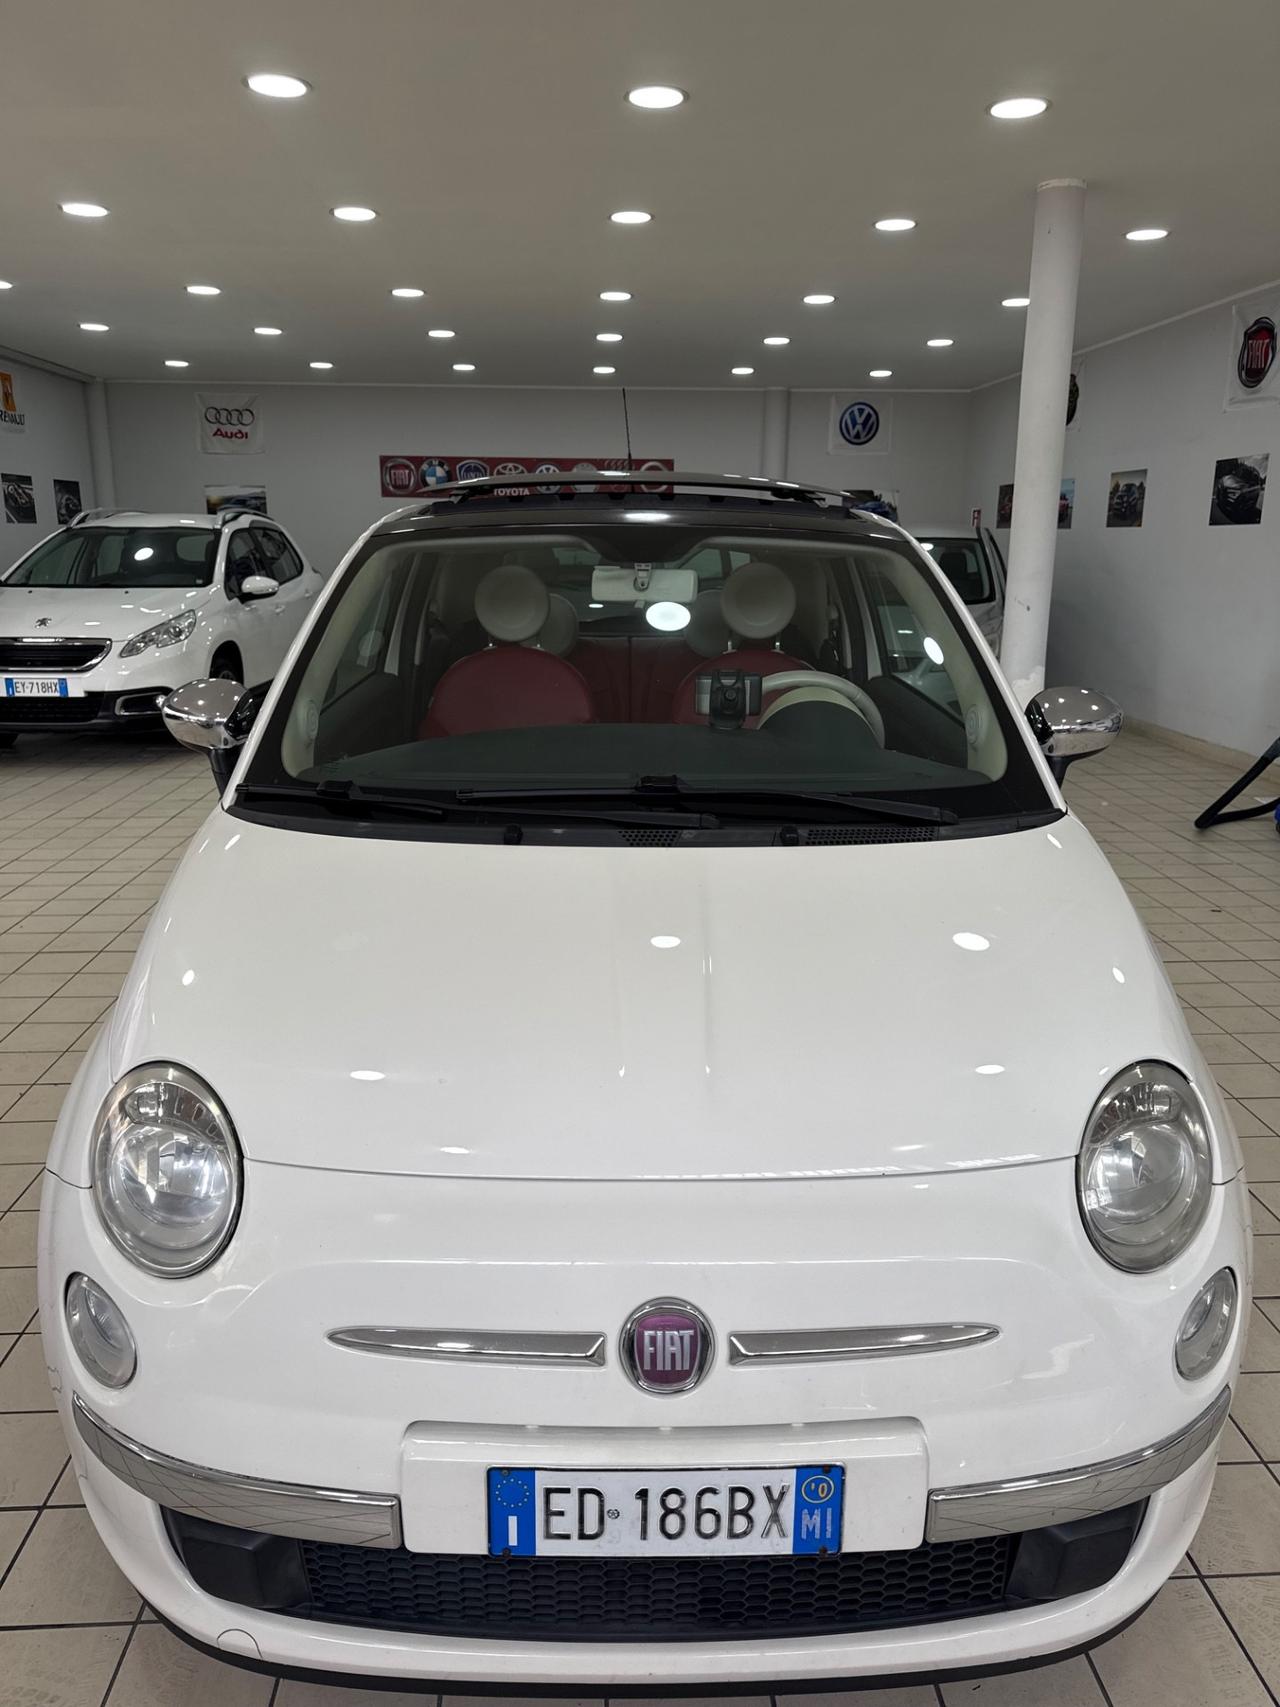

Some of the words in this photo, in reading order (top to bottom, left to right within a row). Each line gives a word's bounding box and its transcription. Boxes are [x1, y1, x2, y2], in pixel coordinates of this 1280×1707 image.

[1247, 338, 1271, 369] FIAT
[212, 427, 249, 440] Audi
[390, 469, 410, 486] FIAT
[643, 1329, 695, 1371] FIAT
[801, 1507, 832, 1540] MI
